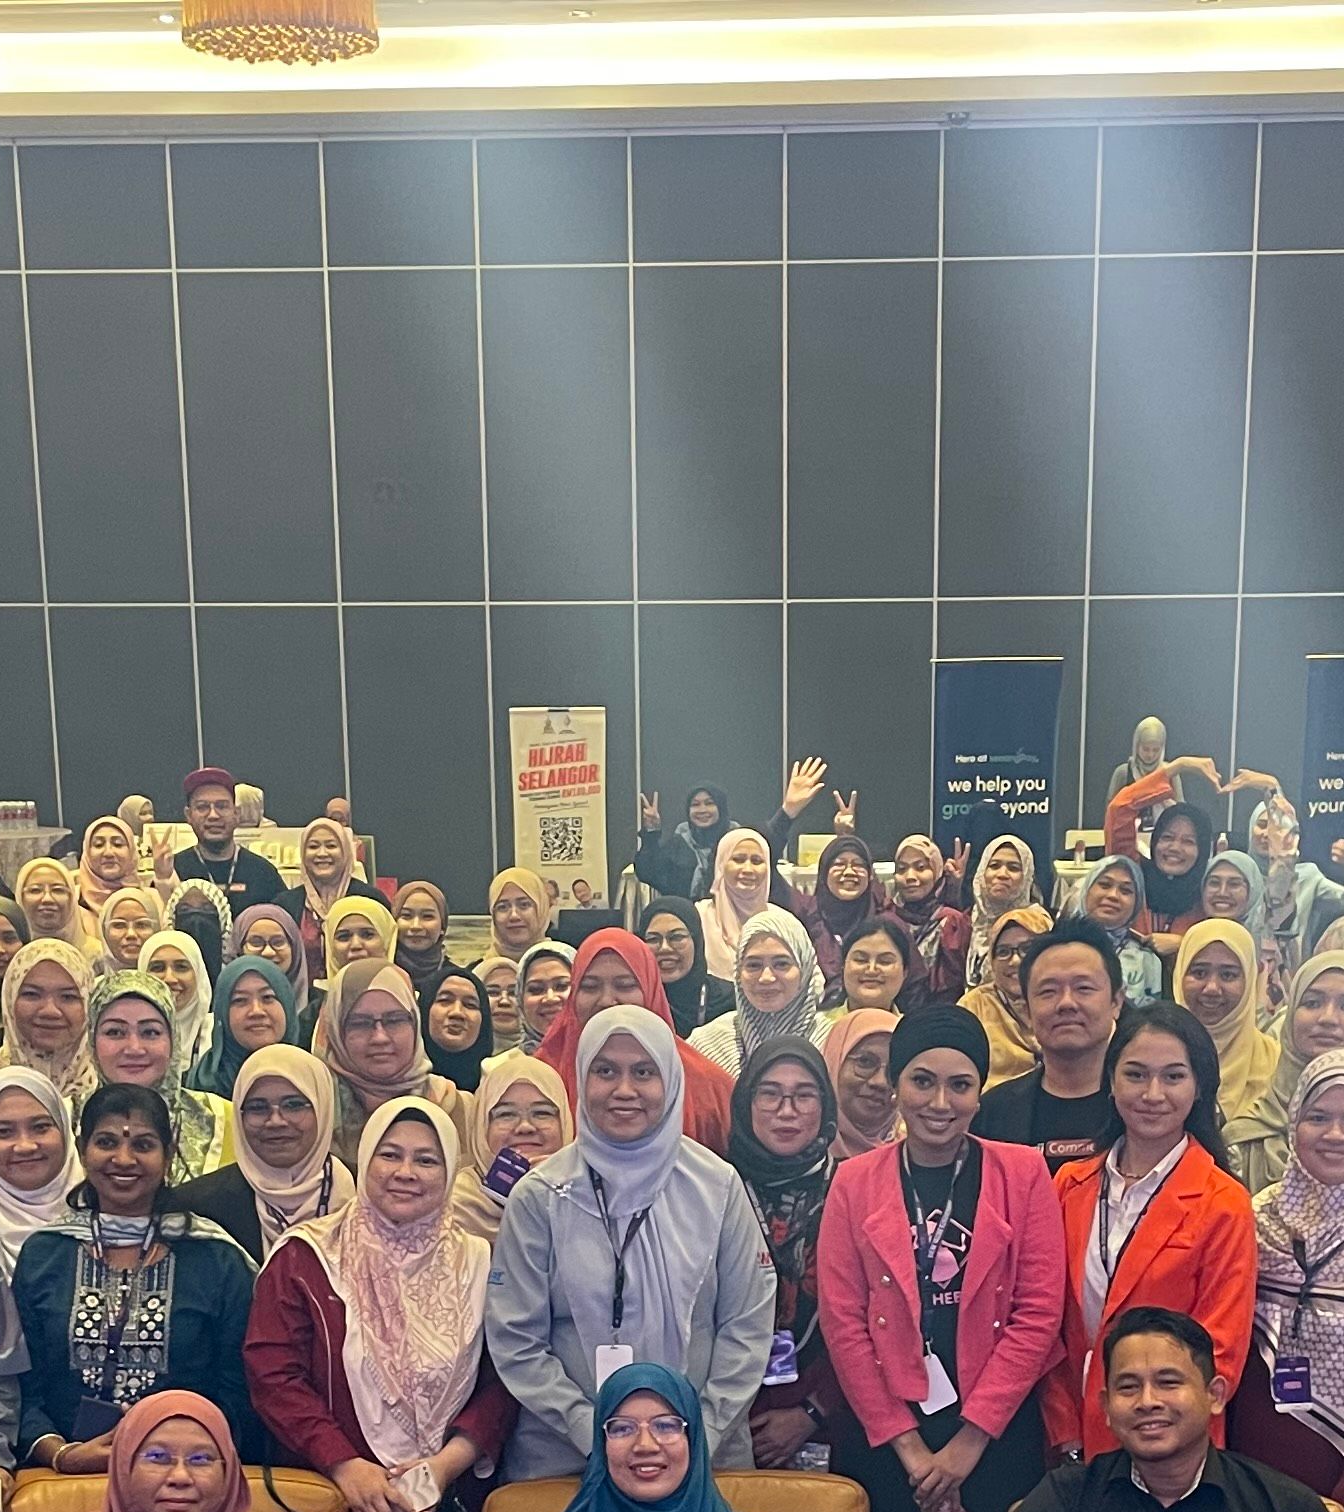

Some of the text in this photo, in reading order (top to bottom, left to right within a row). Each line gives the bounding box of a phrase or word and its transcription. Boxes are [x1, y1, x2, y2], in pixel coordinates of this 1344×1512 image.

[528, 743, 587, 767] HIJRAH
[518, 764, 600, 791] SELANGOR
[947, 775, 1046, 796] we help you
[1318, 778, 1344, 790] we
[941, 797, 1049, 820] gro eyond
